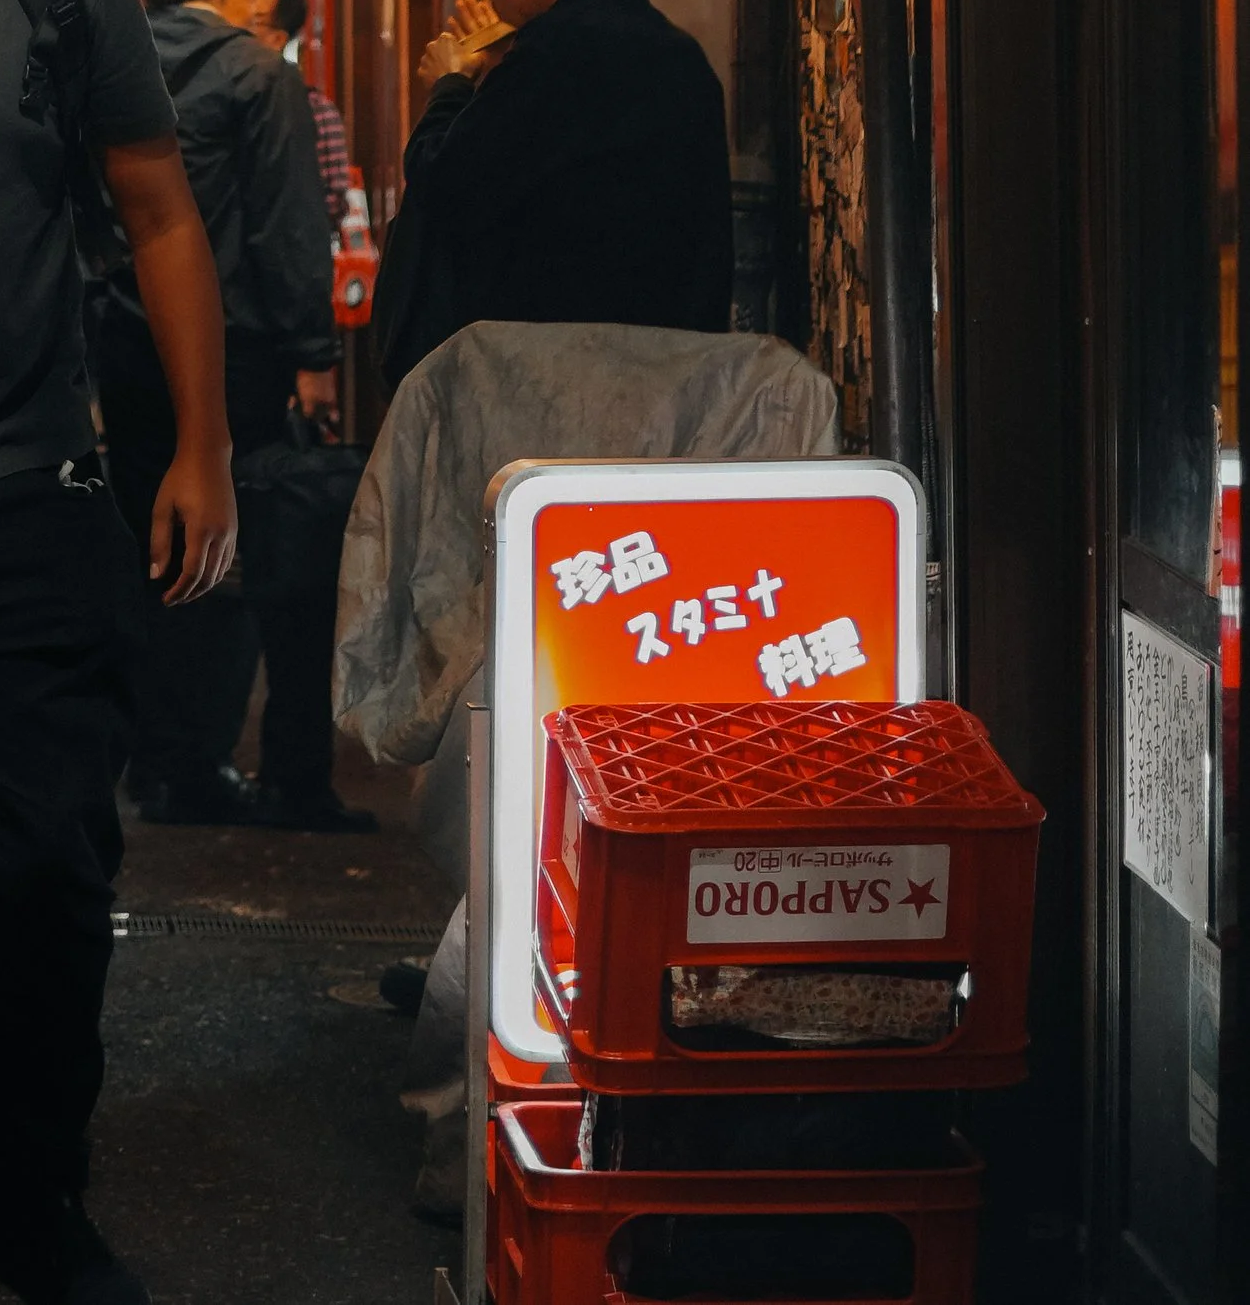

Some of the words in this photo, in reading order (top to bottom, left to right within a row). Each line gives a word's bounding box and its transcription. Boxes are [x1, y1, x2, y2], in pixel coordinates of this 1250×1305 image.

[550, 530, 669, 610] 珍品
[626, 569, 783, 664] スタミナ
[758, 617, 867, 698] 料理
[734, 852, 757, 872] 20
[787, 851, 894, 870] サッポロビール
[695, 879, 891, 917] SAPPORO
